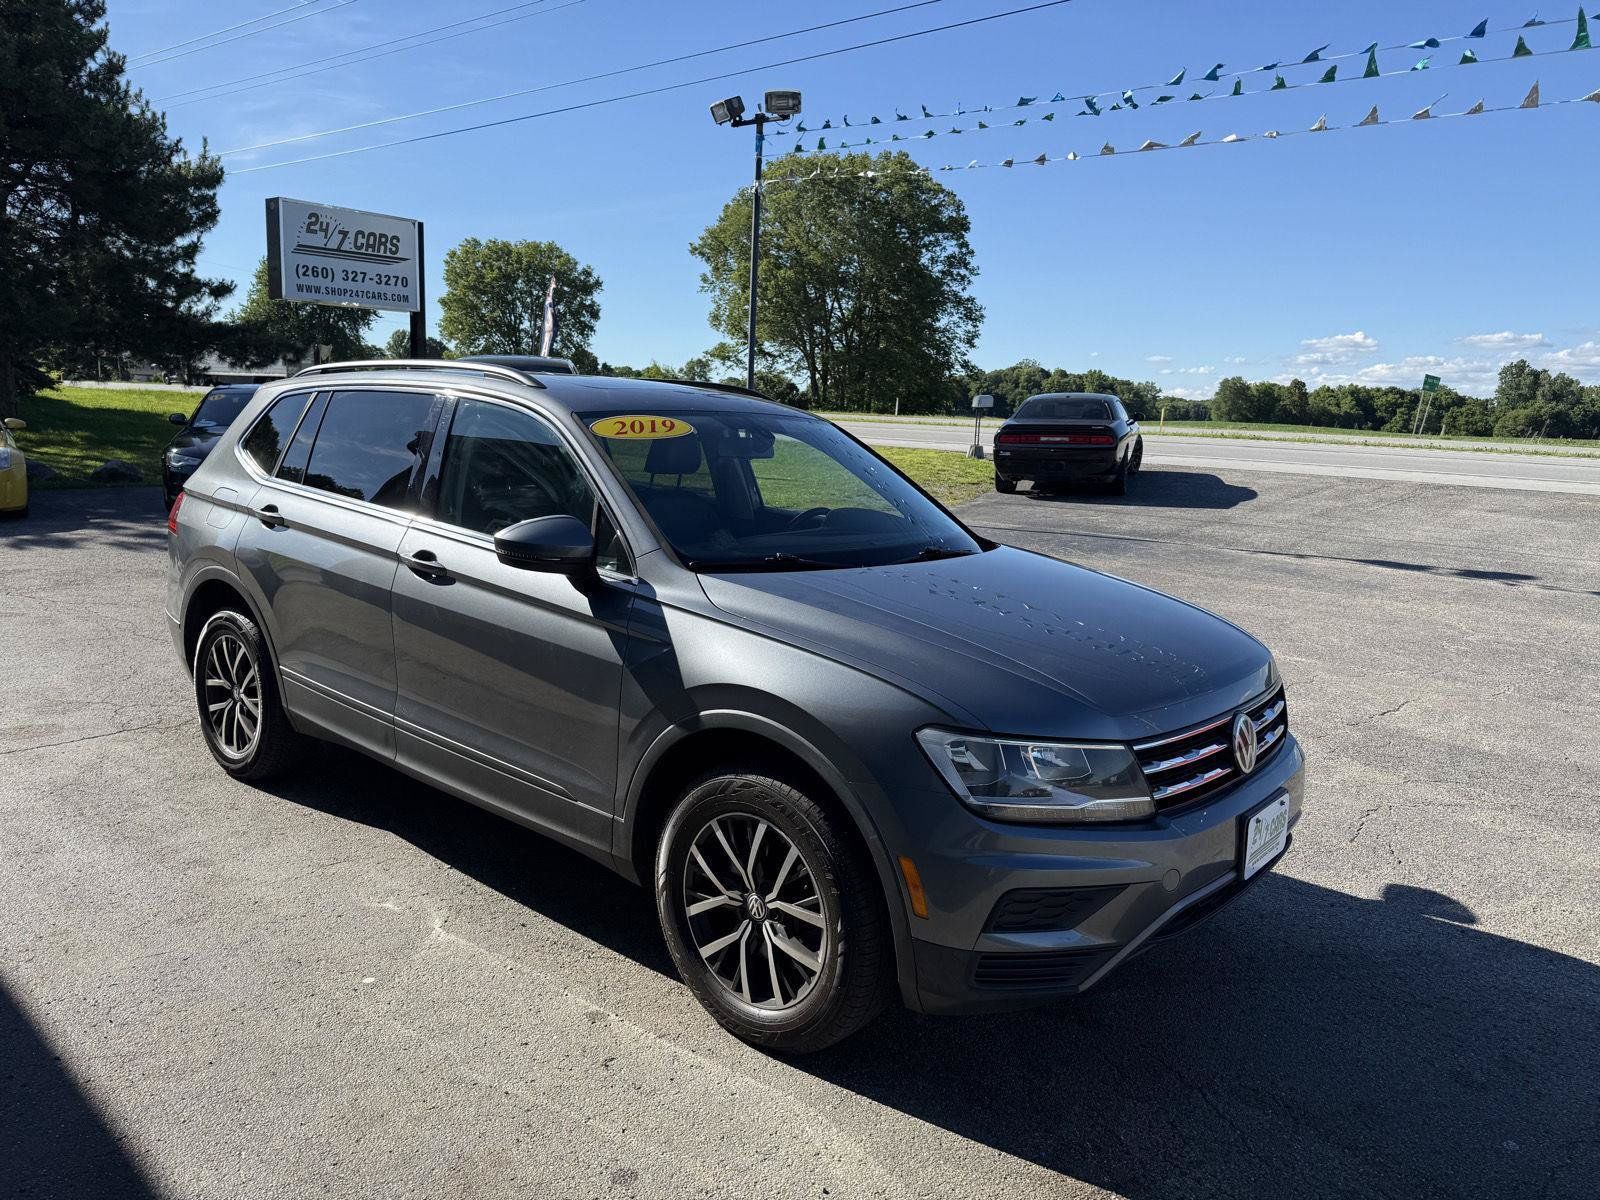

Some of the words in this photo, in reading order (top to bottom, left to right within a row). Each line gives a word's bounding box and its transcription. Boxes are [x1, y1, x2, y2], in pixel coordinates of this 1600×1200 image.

[305, 212, 350, 250] 24/7
[353, 230, 400, 256] CARS
[295, 263, 335, 283] (260)
[342, 269, 409, 288] 327-3270
[296, 283, 410, 303] WWW.SHOP247CARS.COM
[614, 420, 676, 435] 2019
